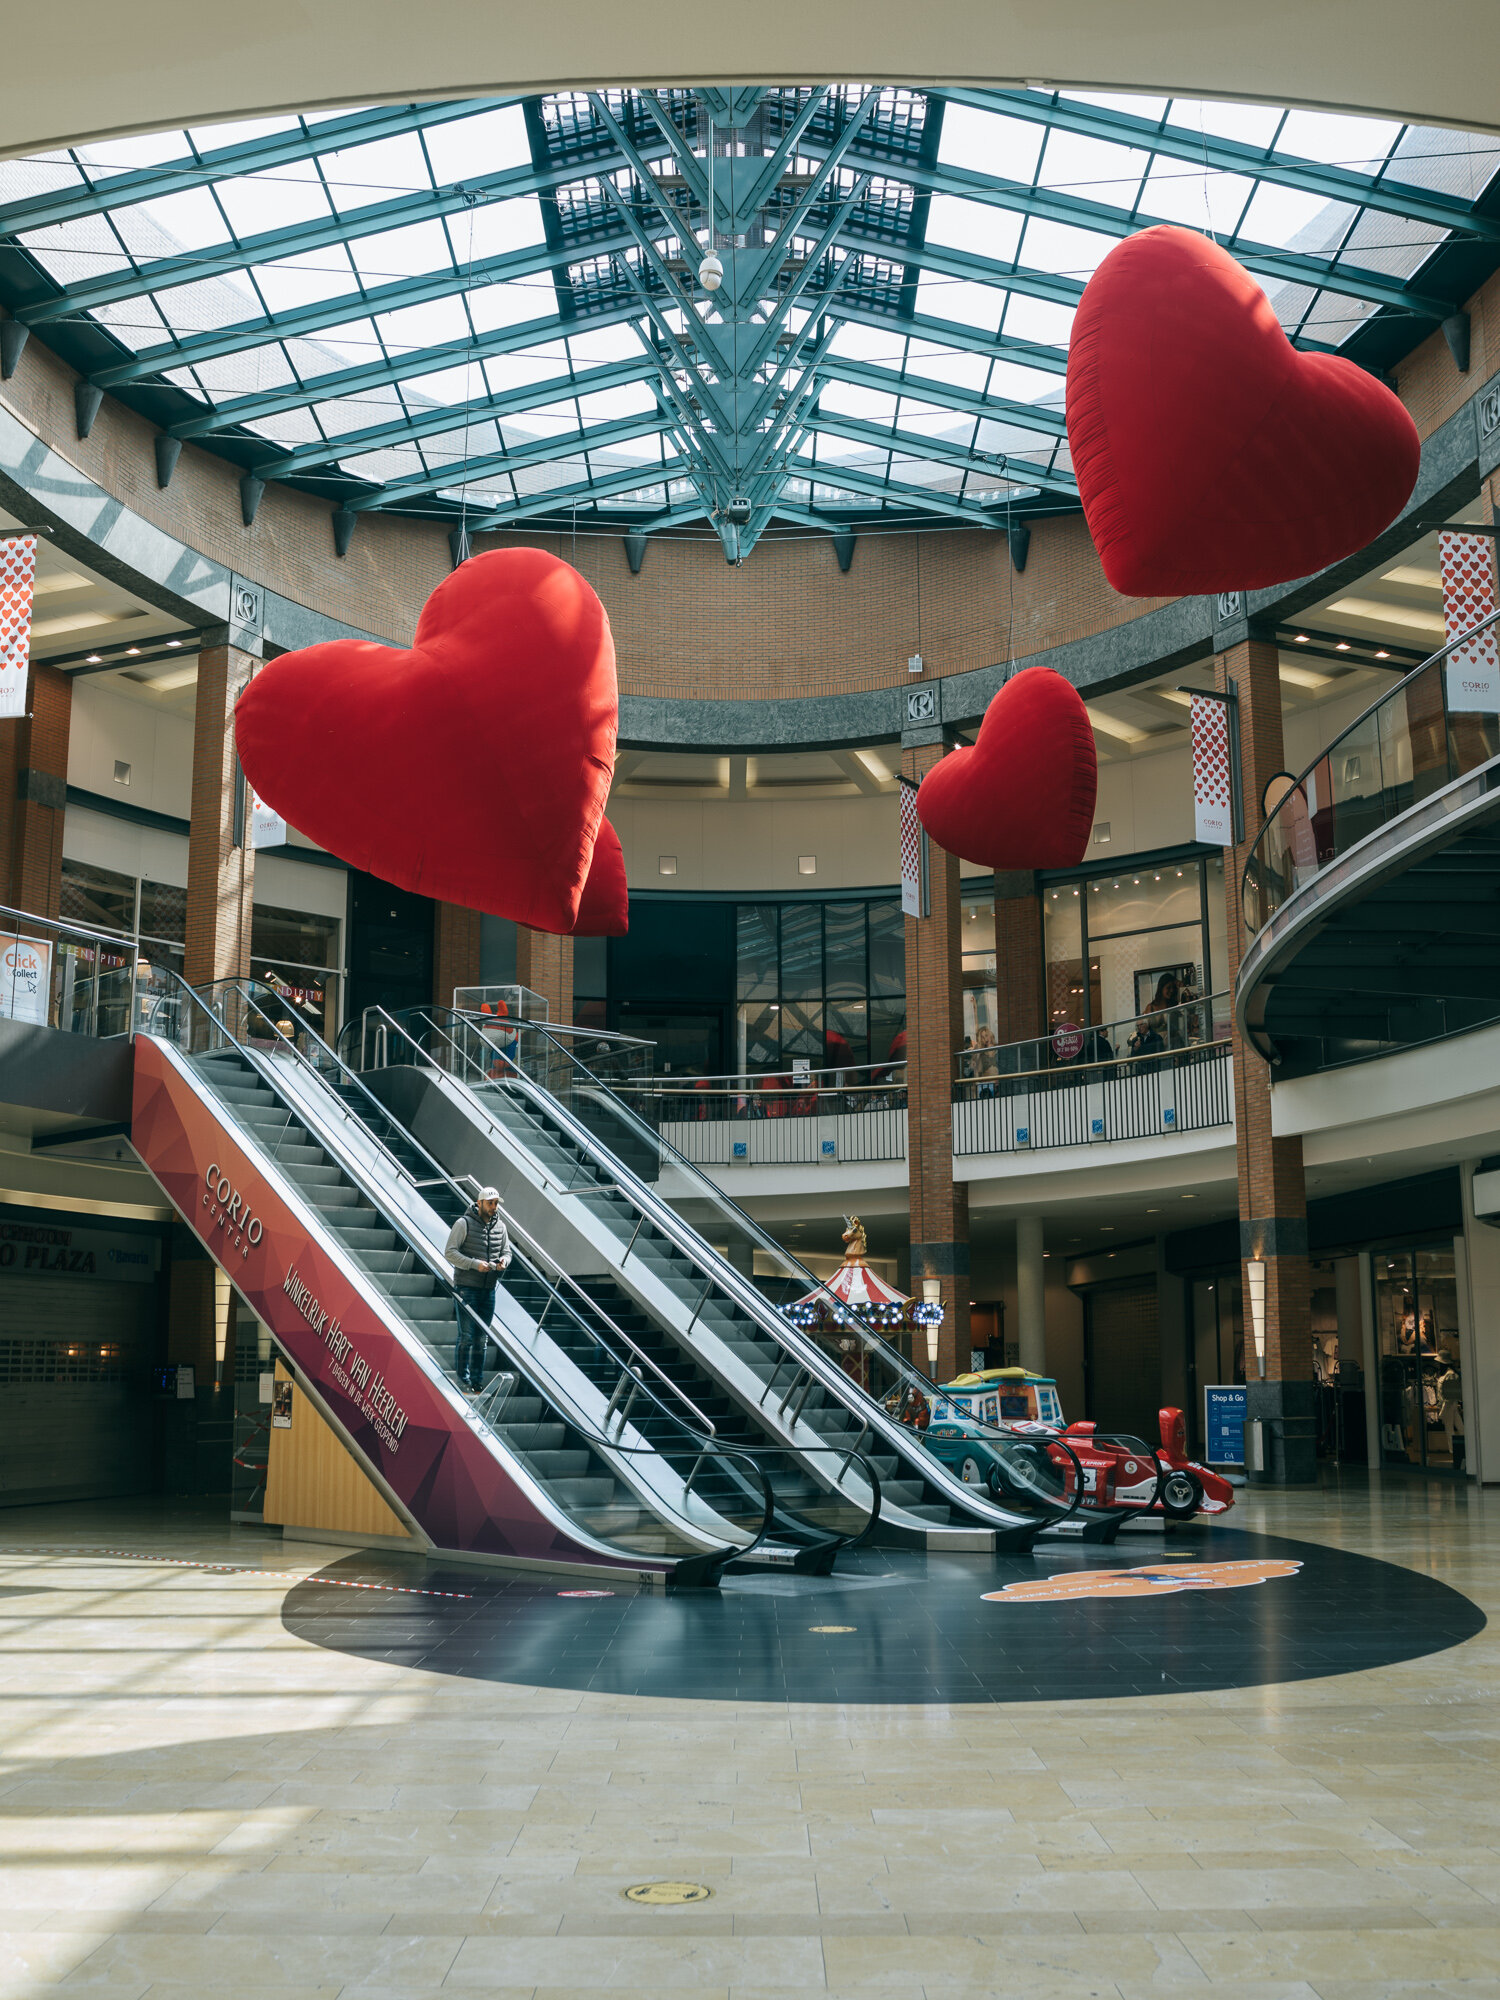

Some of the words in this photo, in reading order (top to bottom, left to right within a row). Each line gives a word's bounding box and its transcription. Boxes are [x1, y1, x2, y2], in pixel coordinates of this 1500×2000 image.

[1462, 681, 1490, 690] CORIO
[5, 953, 37, 969] Cick
[206, 1163, 263, 1244] CORIO
[203, 1194, 248, 1257] CENTER
[24, 1246, 97, 1273] PLAZA
[283, 1262, 329, 1336] WINKELRIJK
[324, 1316, 354, 1366] HART
[349, 1351, 372, 1390] VAN
[368, 1371, 409, 1438] HEERLEN
[328, 1358, 334, 1369] 7
[332, 1363, 350, 1390] DAGEN
[348, 1384, 356, 1398] IN
[354, 1391, 361, 1407] DE
[361, 1398, 375, 1425] WEEK
[374, 1418, 400, 1455] GEOPEND!
[1212, 1394, 1228, 1403] Shop
[1228, 1394, 1233, 1402] &
[1234, 1394, 1244, 1402] Go
[1127, 1463, 1135, 1473] 5
